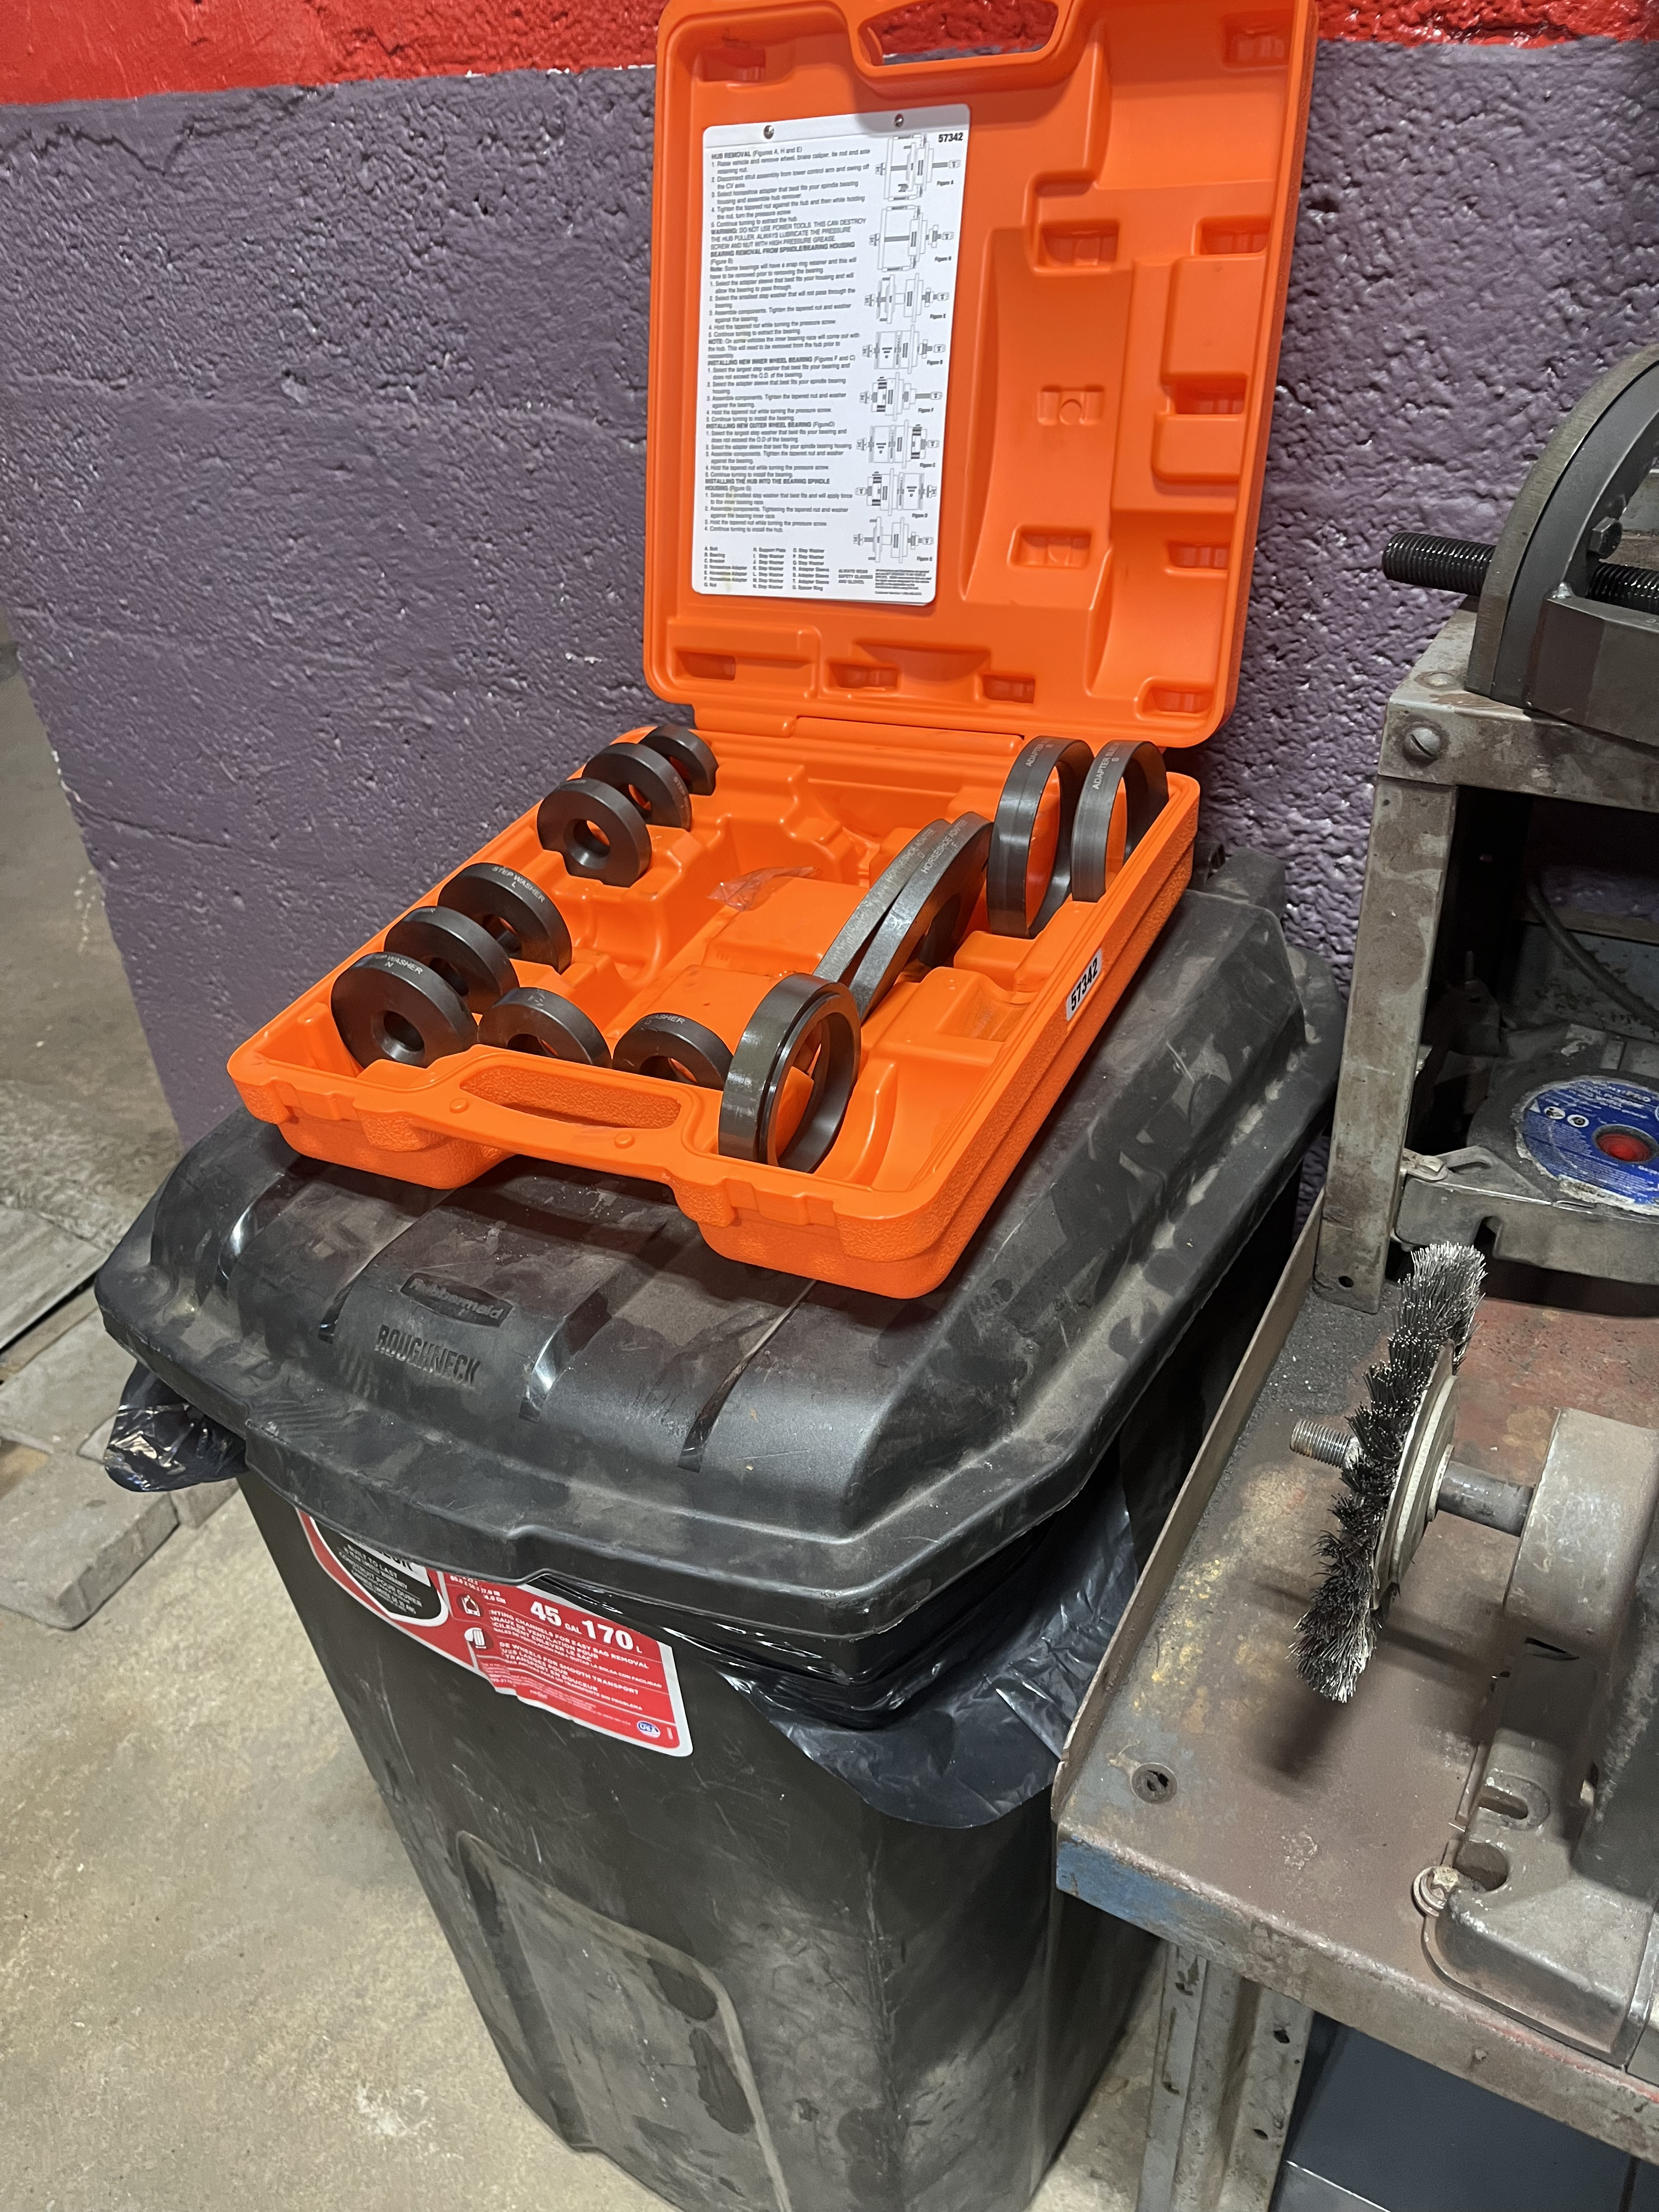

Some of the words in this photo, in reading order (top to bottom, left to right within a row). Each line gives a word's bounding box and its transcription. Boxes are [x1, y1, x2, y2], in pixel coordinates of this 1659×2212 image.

[938, 132, 964, 143] 57342
[1092, 757, 1111, 790] ADAPTER
[921, 836, 952, 874] HORSESHOE
[492, 866, 514, 877] STEP
[514, 874, 545, 903] WASHER
[1071, 957, 1098, 1011] 57342
[374, 1324, 482, 1388] ROUGHNECK
[379, 1564, 397, 1578] LAST
[530, 1601, 562, 1627] 45
[565, 1623, 582, 1635] GAL
[515, 1618, 554, 1637] CHANNELS
[555, 1632, 571, 1643] FOR
[572, 1640, 591, 1651] EASY
[592, 1646, 610, 1657] BAG
[611, 1653, 650, 1669] REMOVAL
[527, 1628, 576, 1651] VENTILATION
[577, 1647, 599, 1660] POUR
[531, 1635, 565, 1652] ENLEVER
[566, 1648, 575, 1656] LE
[577, 1653, 592, 1662] SAC
[582, 1620, 634, 1650] 170
[636, 1645, 643, 1654] L
[505, 1654, 548, 1672] TRANSPORT
[561, 1674, 598, 1691] DOUCEUR
[511, 1644, 542, 1660] WHEELS
[543, 1657, 558, 1666] FOR
[559, 1663, 591, 1679] SMOOTH
[592, 1675, 639, 1695] TRANSPORT
[518, 1651, 546, 1667] LARGES
[547, 1664, 568, 1675] POUR
[599, 1666, 618, 1675] BOLSA
[631, 1676, 662, 1688] FACILIDAD
[611, 1697, 643, 1711] PROBLEMA
[639, 1722, 659, 1733] USA
